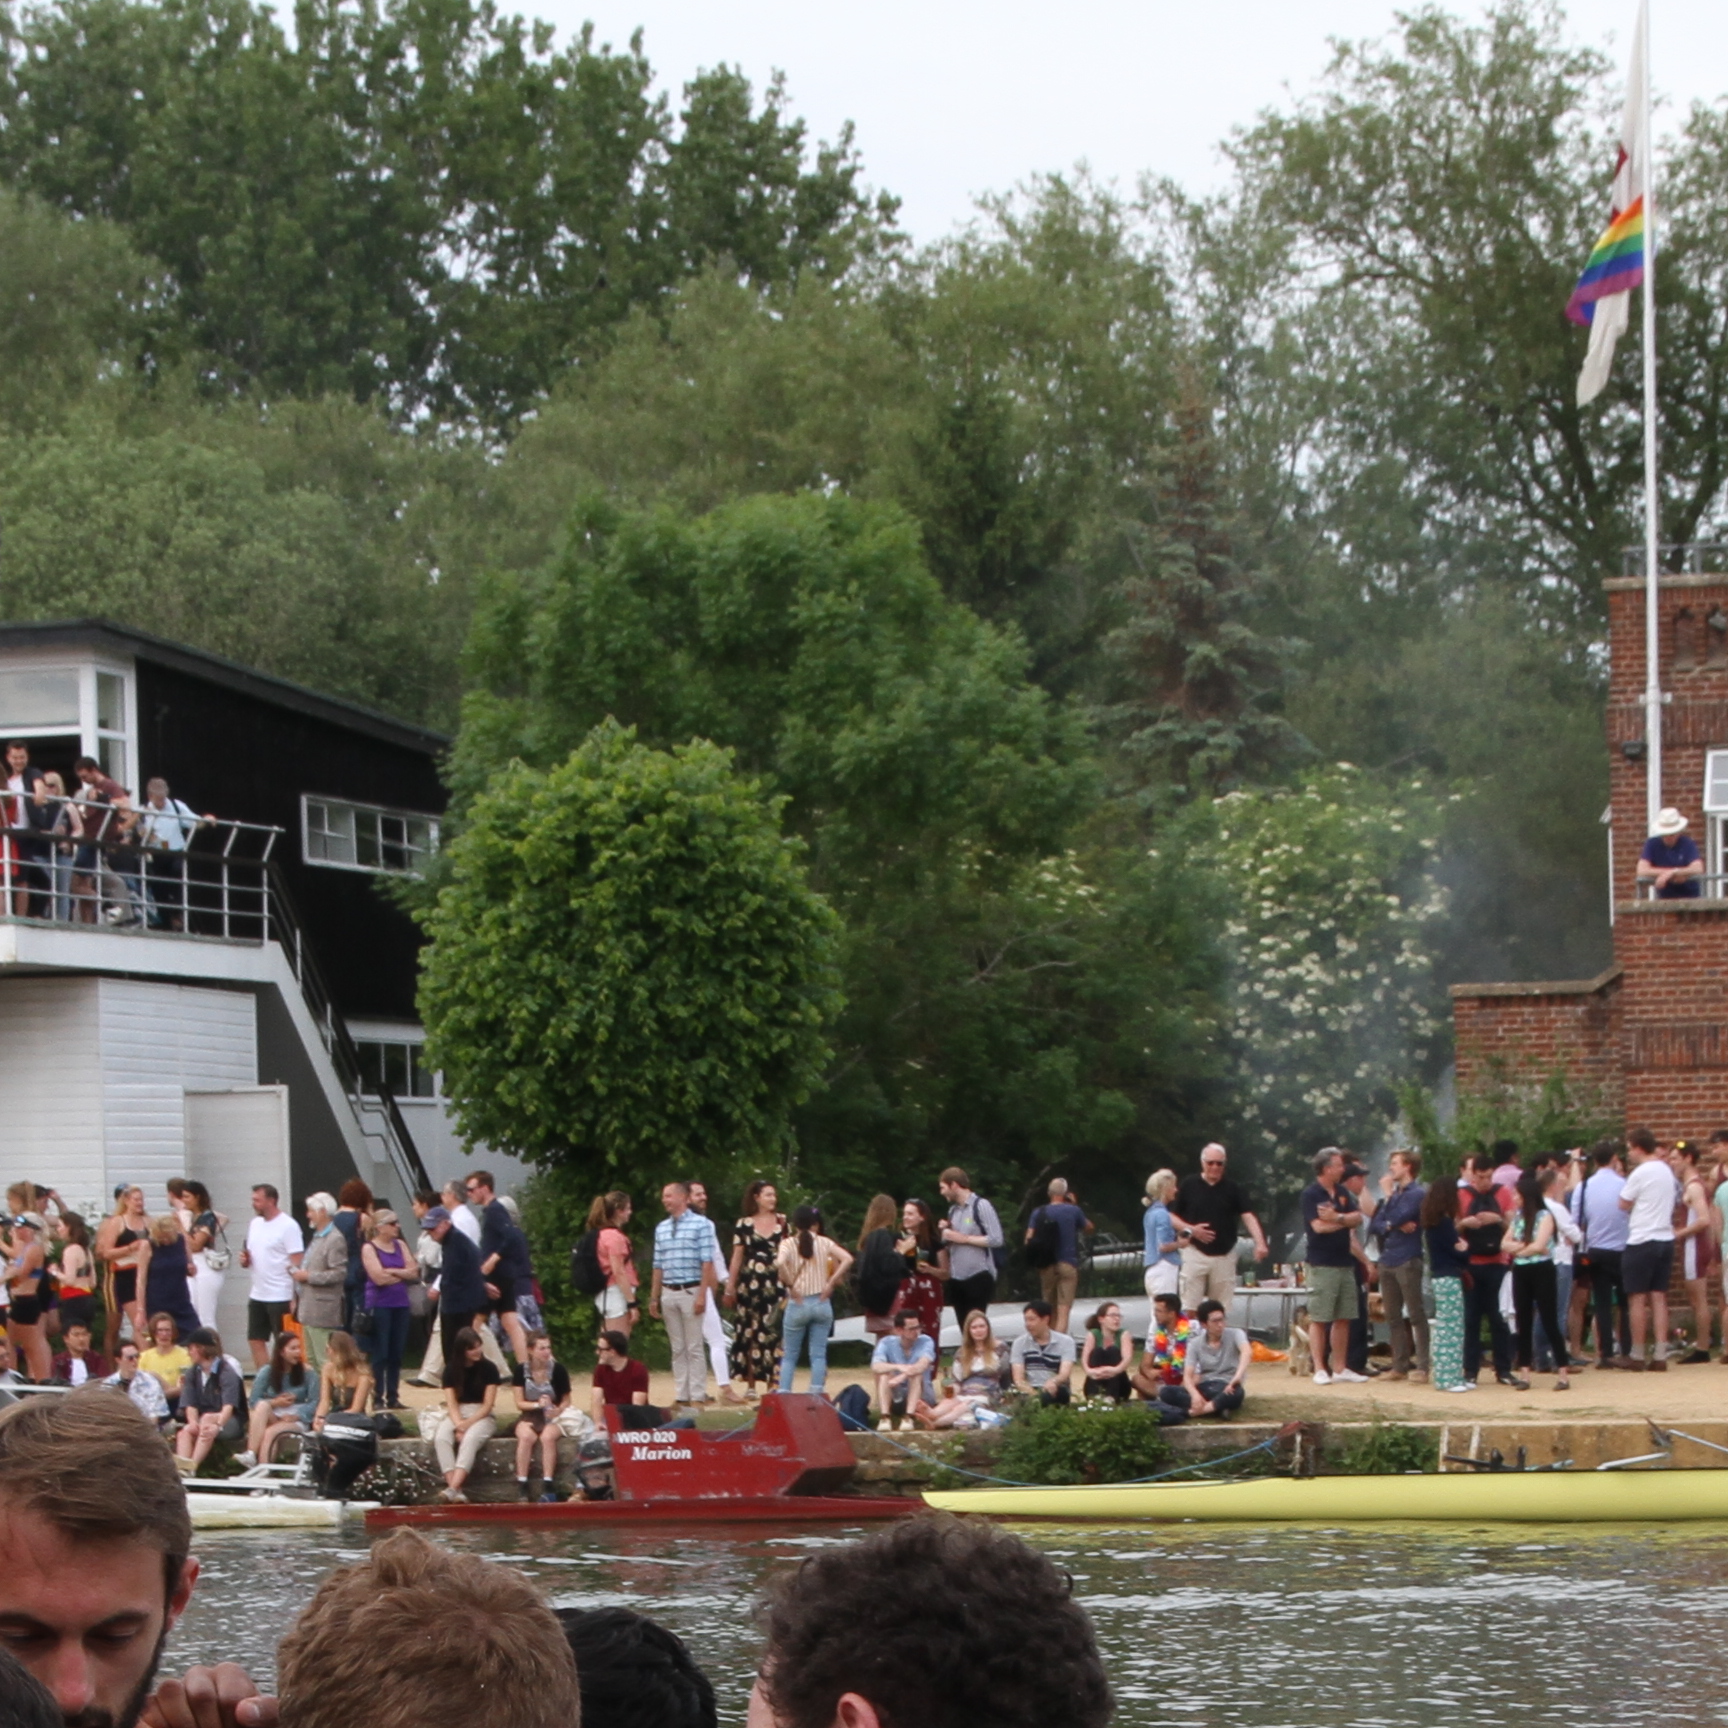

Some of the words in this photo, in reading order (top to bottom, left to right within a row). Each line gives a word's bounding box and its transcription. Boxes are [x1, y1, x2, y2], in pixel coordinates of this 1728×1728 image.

[616, 1431, 650, 1444] WRO
[653, 1431, 677, 1443] 020
[630, 1445, 693, 1461] Marion
